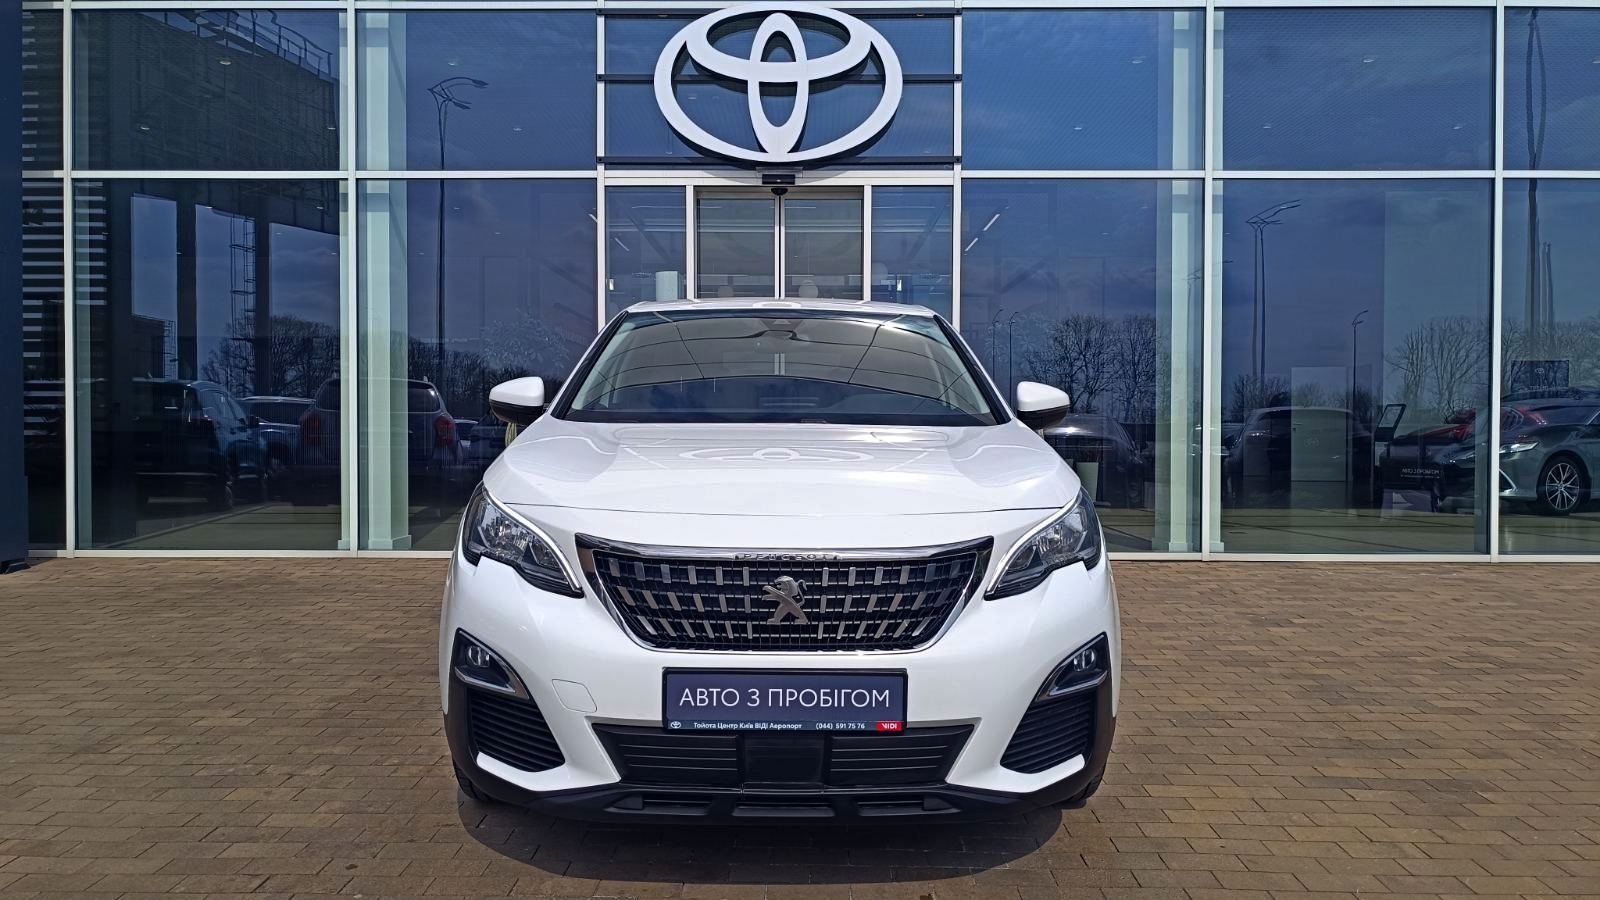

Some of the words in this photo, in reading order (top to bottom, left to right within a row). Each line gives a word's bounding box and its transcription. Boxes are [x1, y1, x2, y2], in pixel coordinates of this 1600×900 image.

[679, 688, 740, 707] АВТО
[768, 688, 889, 708] ПРОБІГОМ
[717, 722, 738, 731] Центр
[769, 722, 802, 731] Аеропорт
[815, 722, 833, 730] (044)
